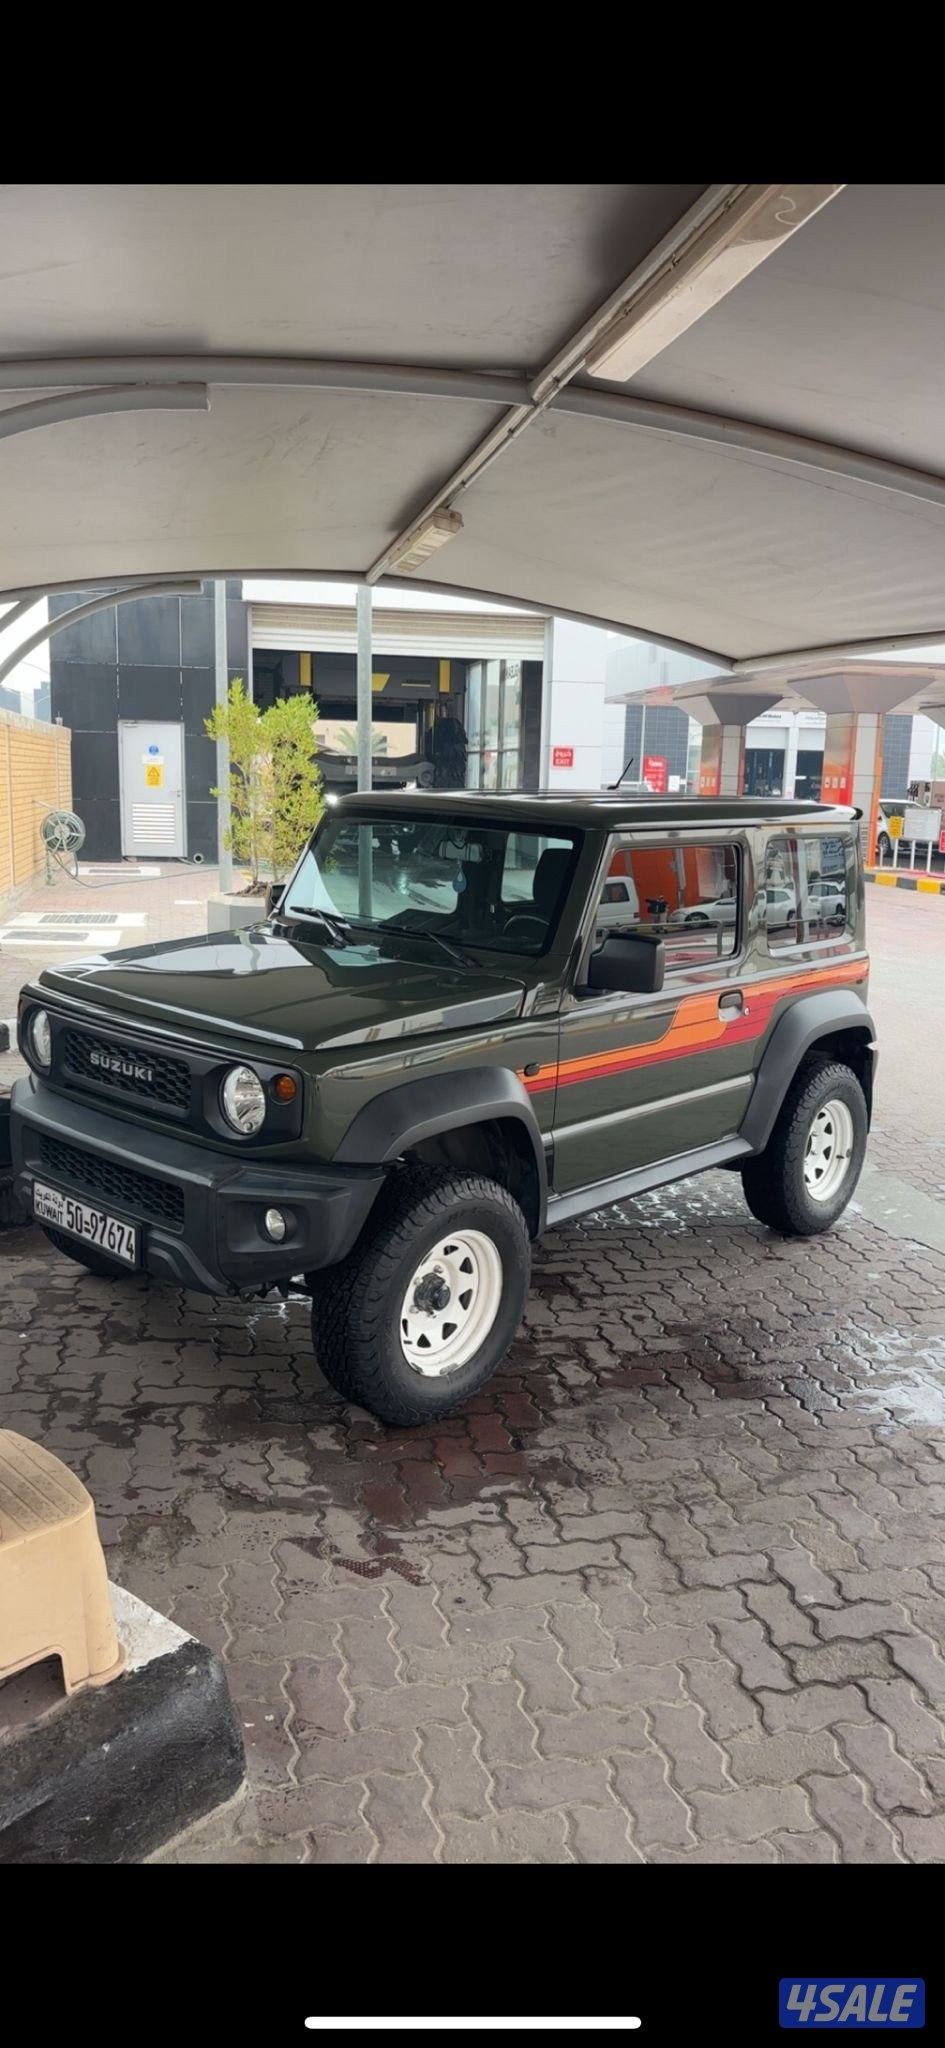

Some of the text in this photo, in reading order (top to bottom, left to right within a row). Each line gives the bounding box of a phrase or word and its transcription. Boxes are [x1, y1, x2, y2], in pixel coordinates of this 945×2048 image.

[555, 758, 570, 766] EXIT
[90, 1052, 152, 1082] SUZUKI
[36, 1199, 63, 1225] KUWAIT
